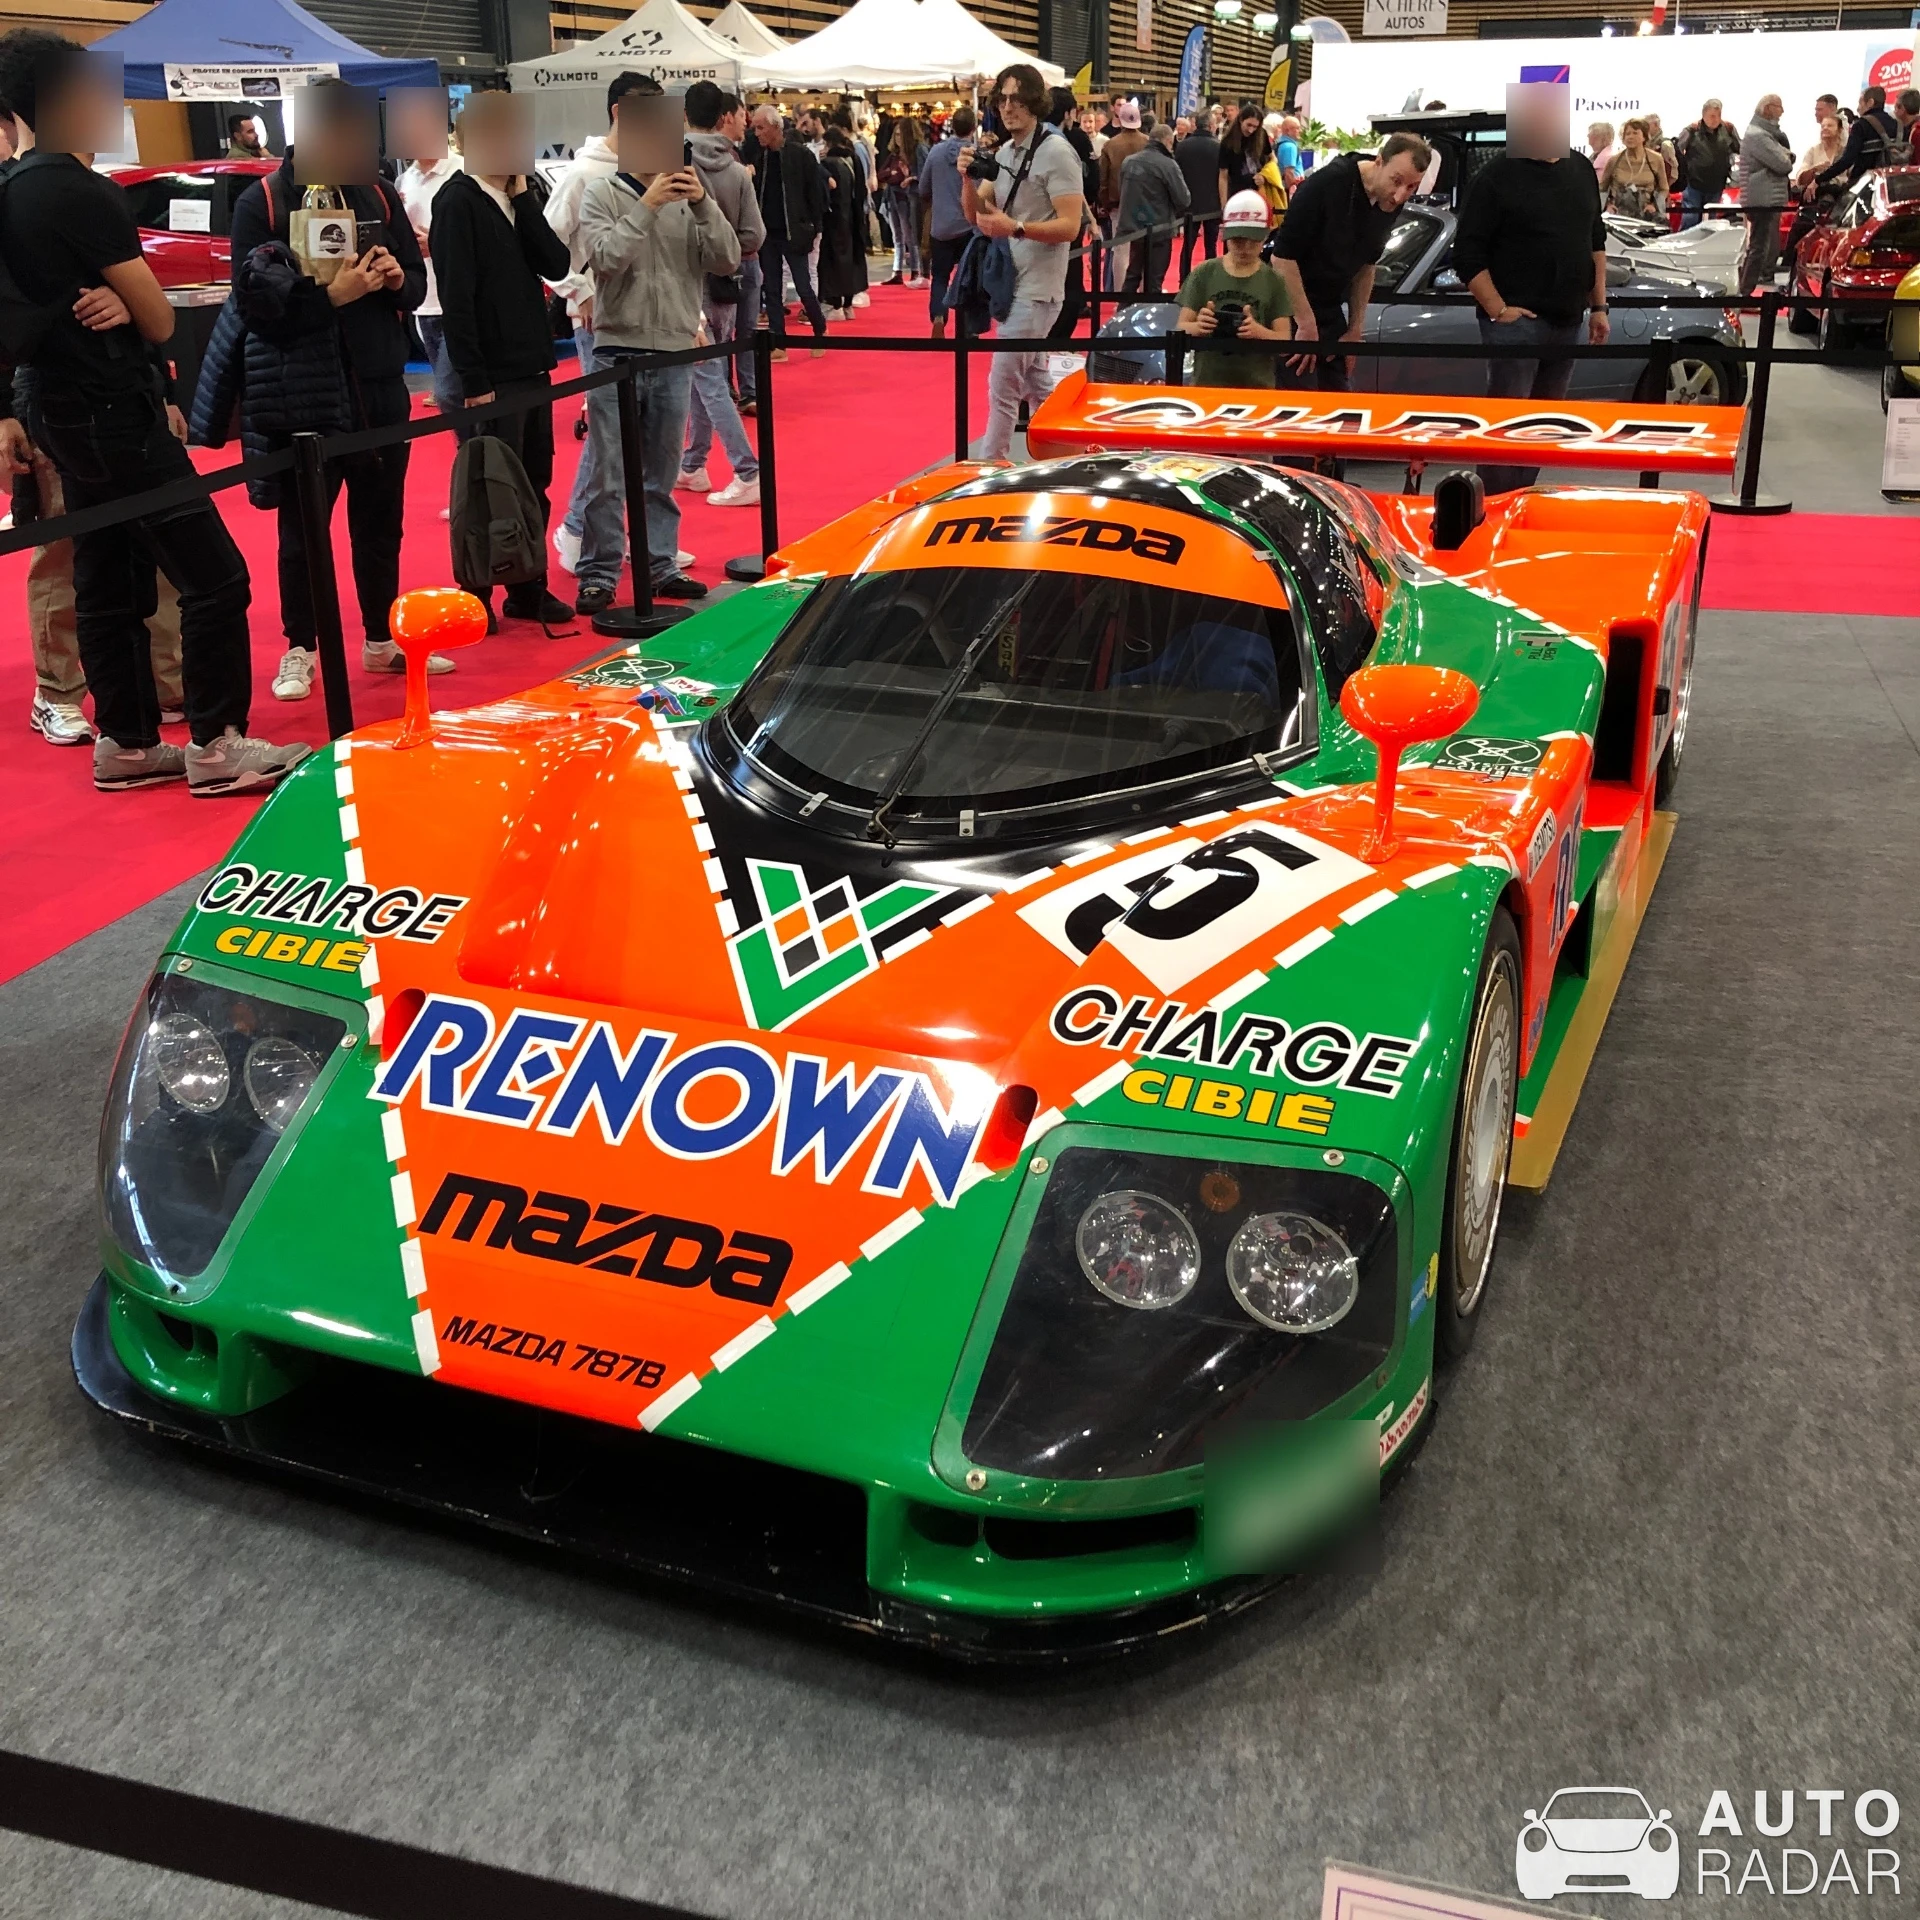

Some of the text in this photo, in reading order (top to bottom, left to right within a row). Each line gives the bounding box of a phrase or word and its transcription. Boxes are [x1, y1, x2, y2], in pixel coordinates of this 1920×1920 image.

[1385, 16, 1425, 29] AUTOS
[553, 71, 598, 81] XLMOTO
[669, 69, 716, 79] XLMOTO
[1878, 60, 1912, 80] -20%
[1575, 96, 1640, 111] Passion
[1083, 397, 1708, 448] CHARGE
[196, 863, 471, 945] CHARGE
[1049, 984, 1421, 1100] CHARGE
[366, 992, 999, 1209] RENOWN
[441, 1316, 667, 1389] MAZDA 787B
